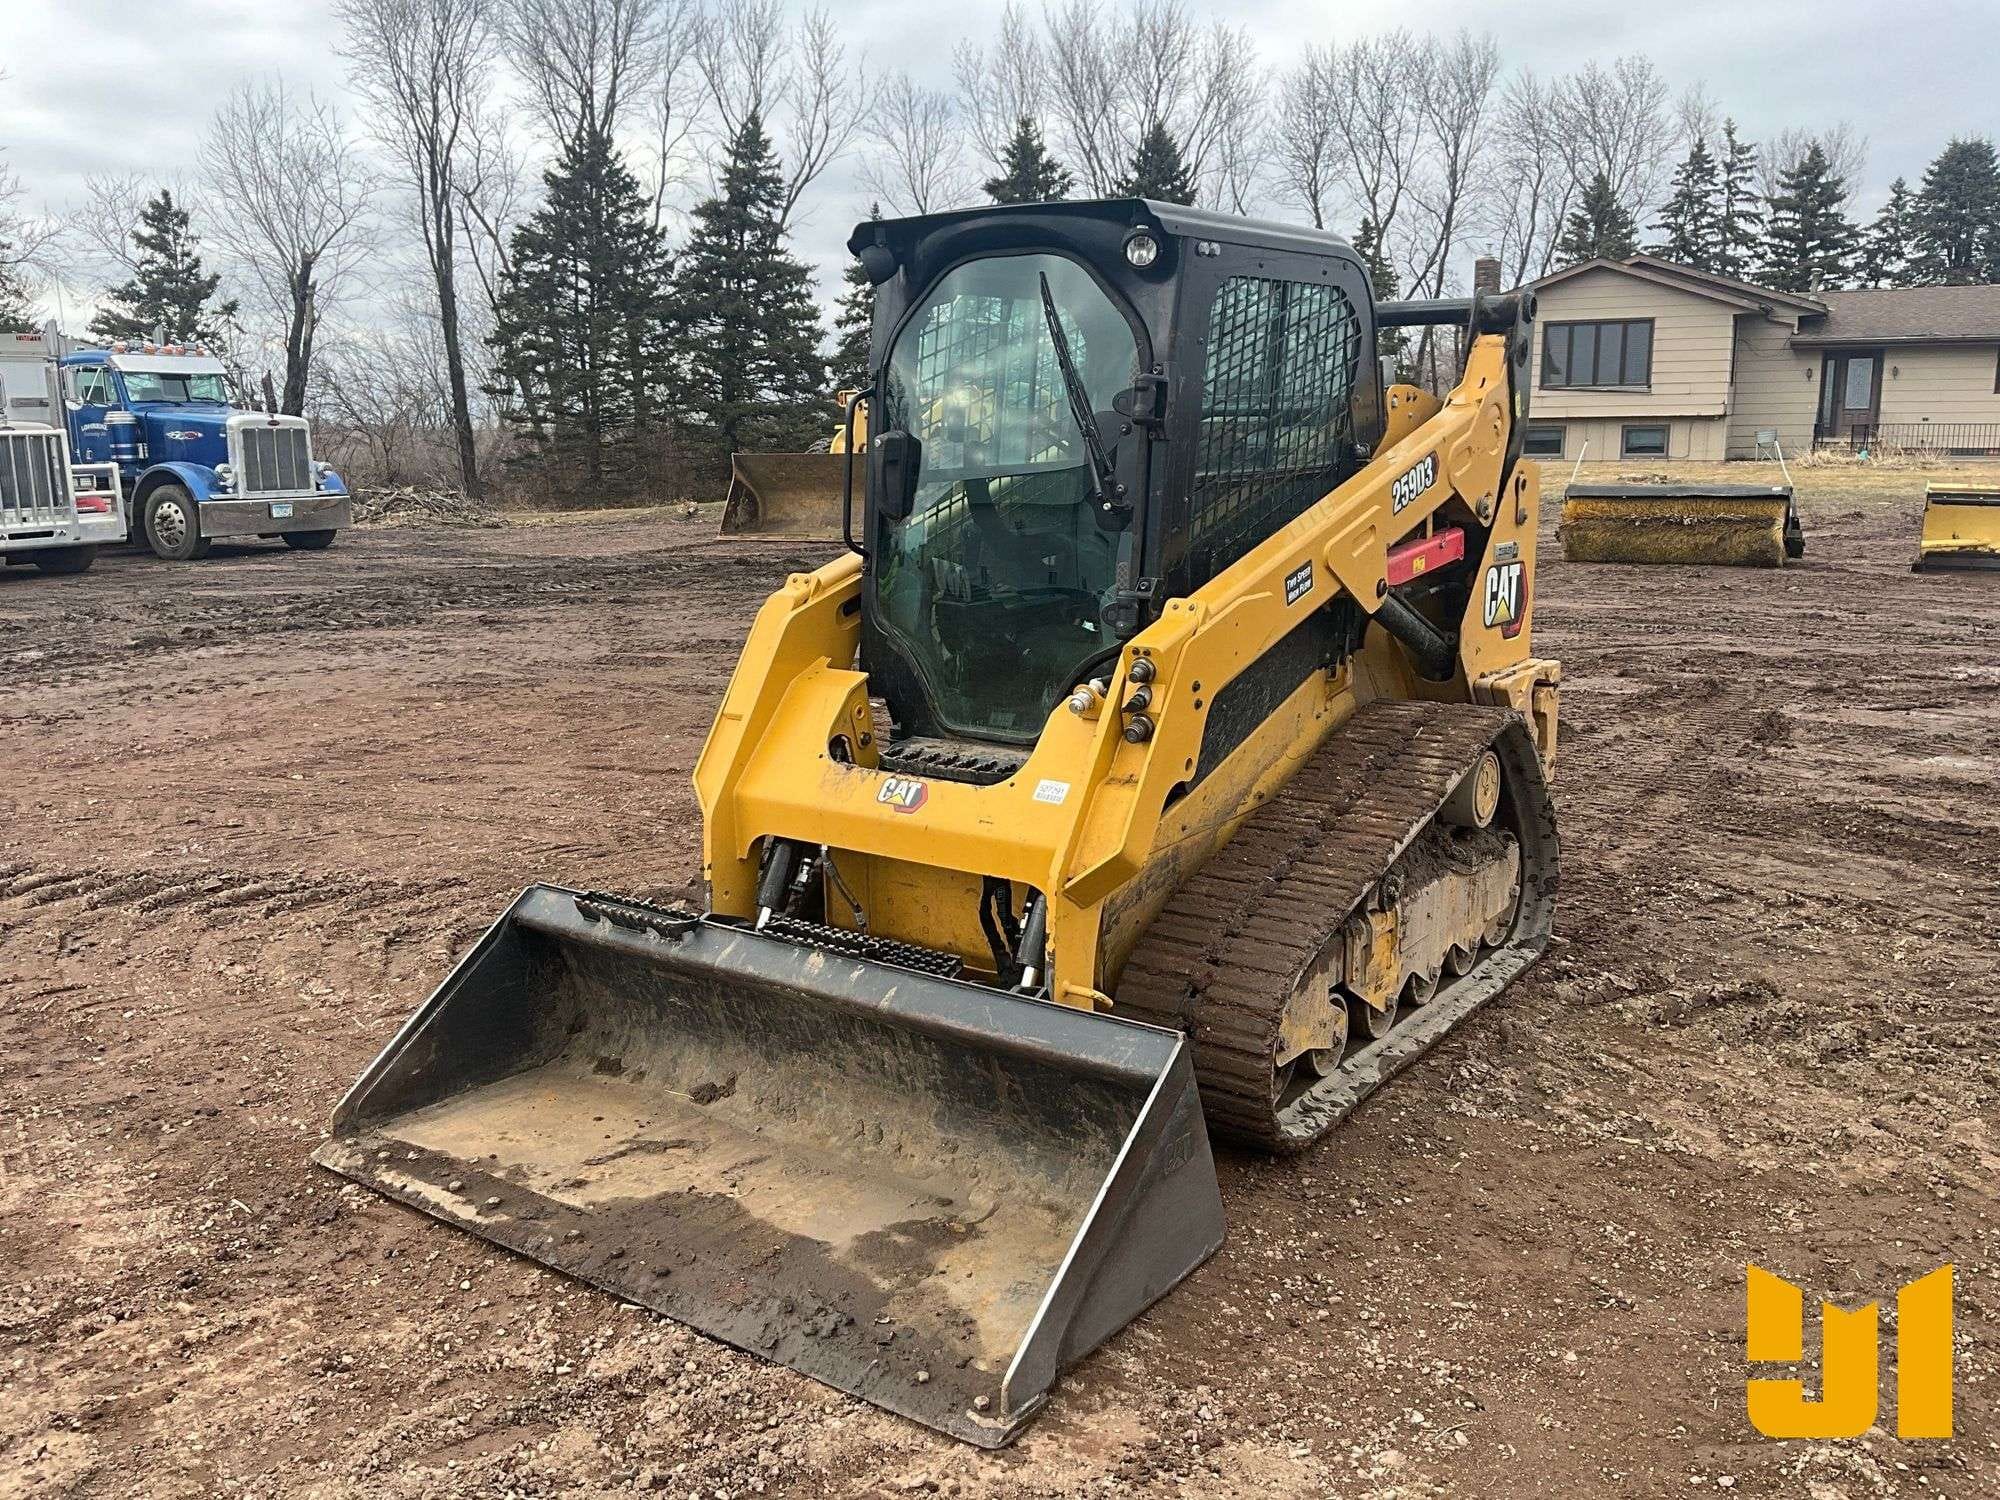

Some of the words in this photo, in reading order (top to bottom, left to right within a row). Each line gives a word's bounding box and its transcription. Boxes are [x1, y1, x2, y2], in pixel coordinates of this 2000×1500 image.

[1392, 455, 1433, 514] 259D3
[1484, 563, 1520, 626] CAT
[878, 778, 923, 807] CAT
